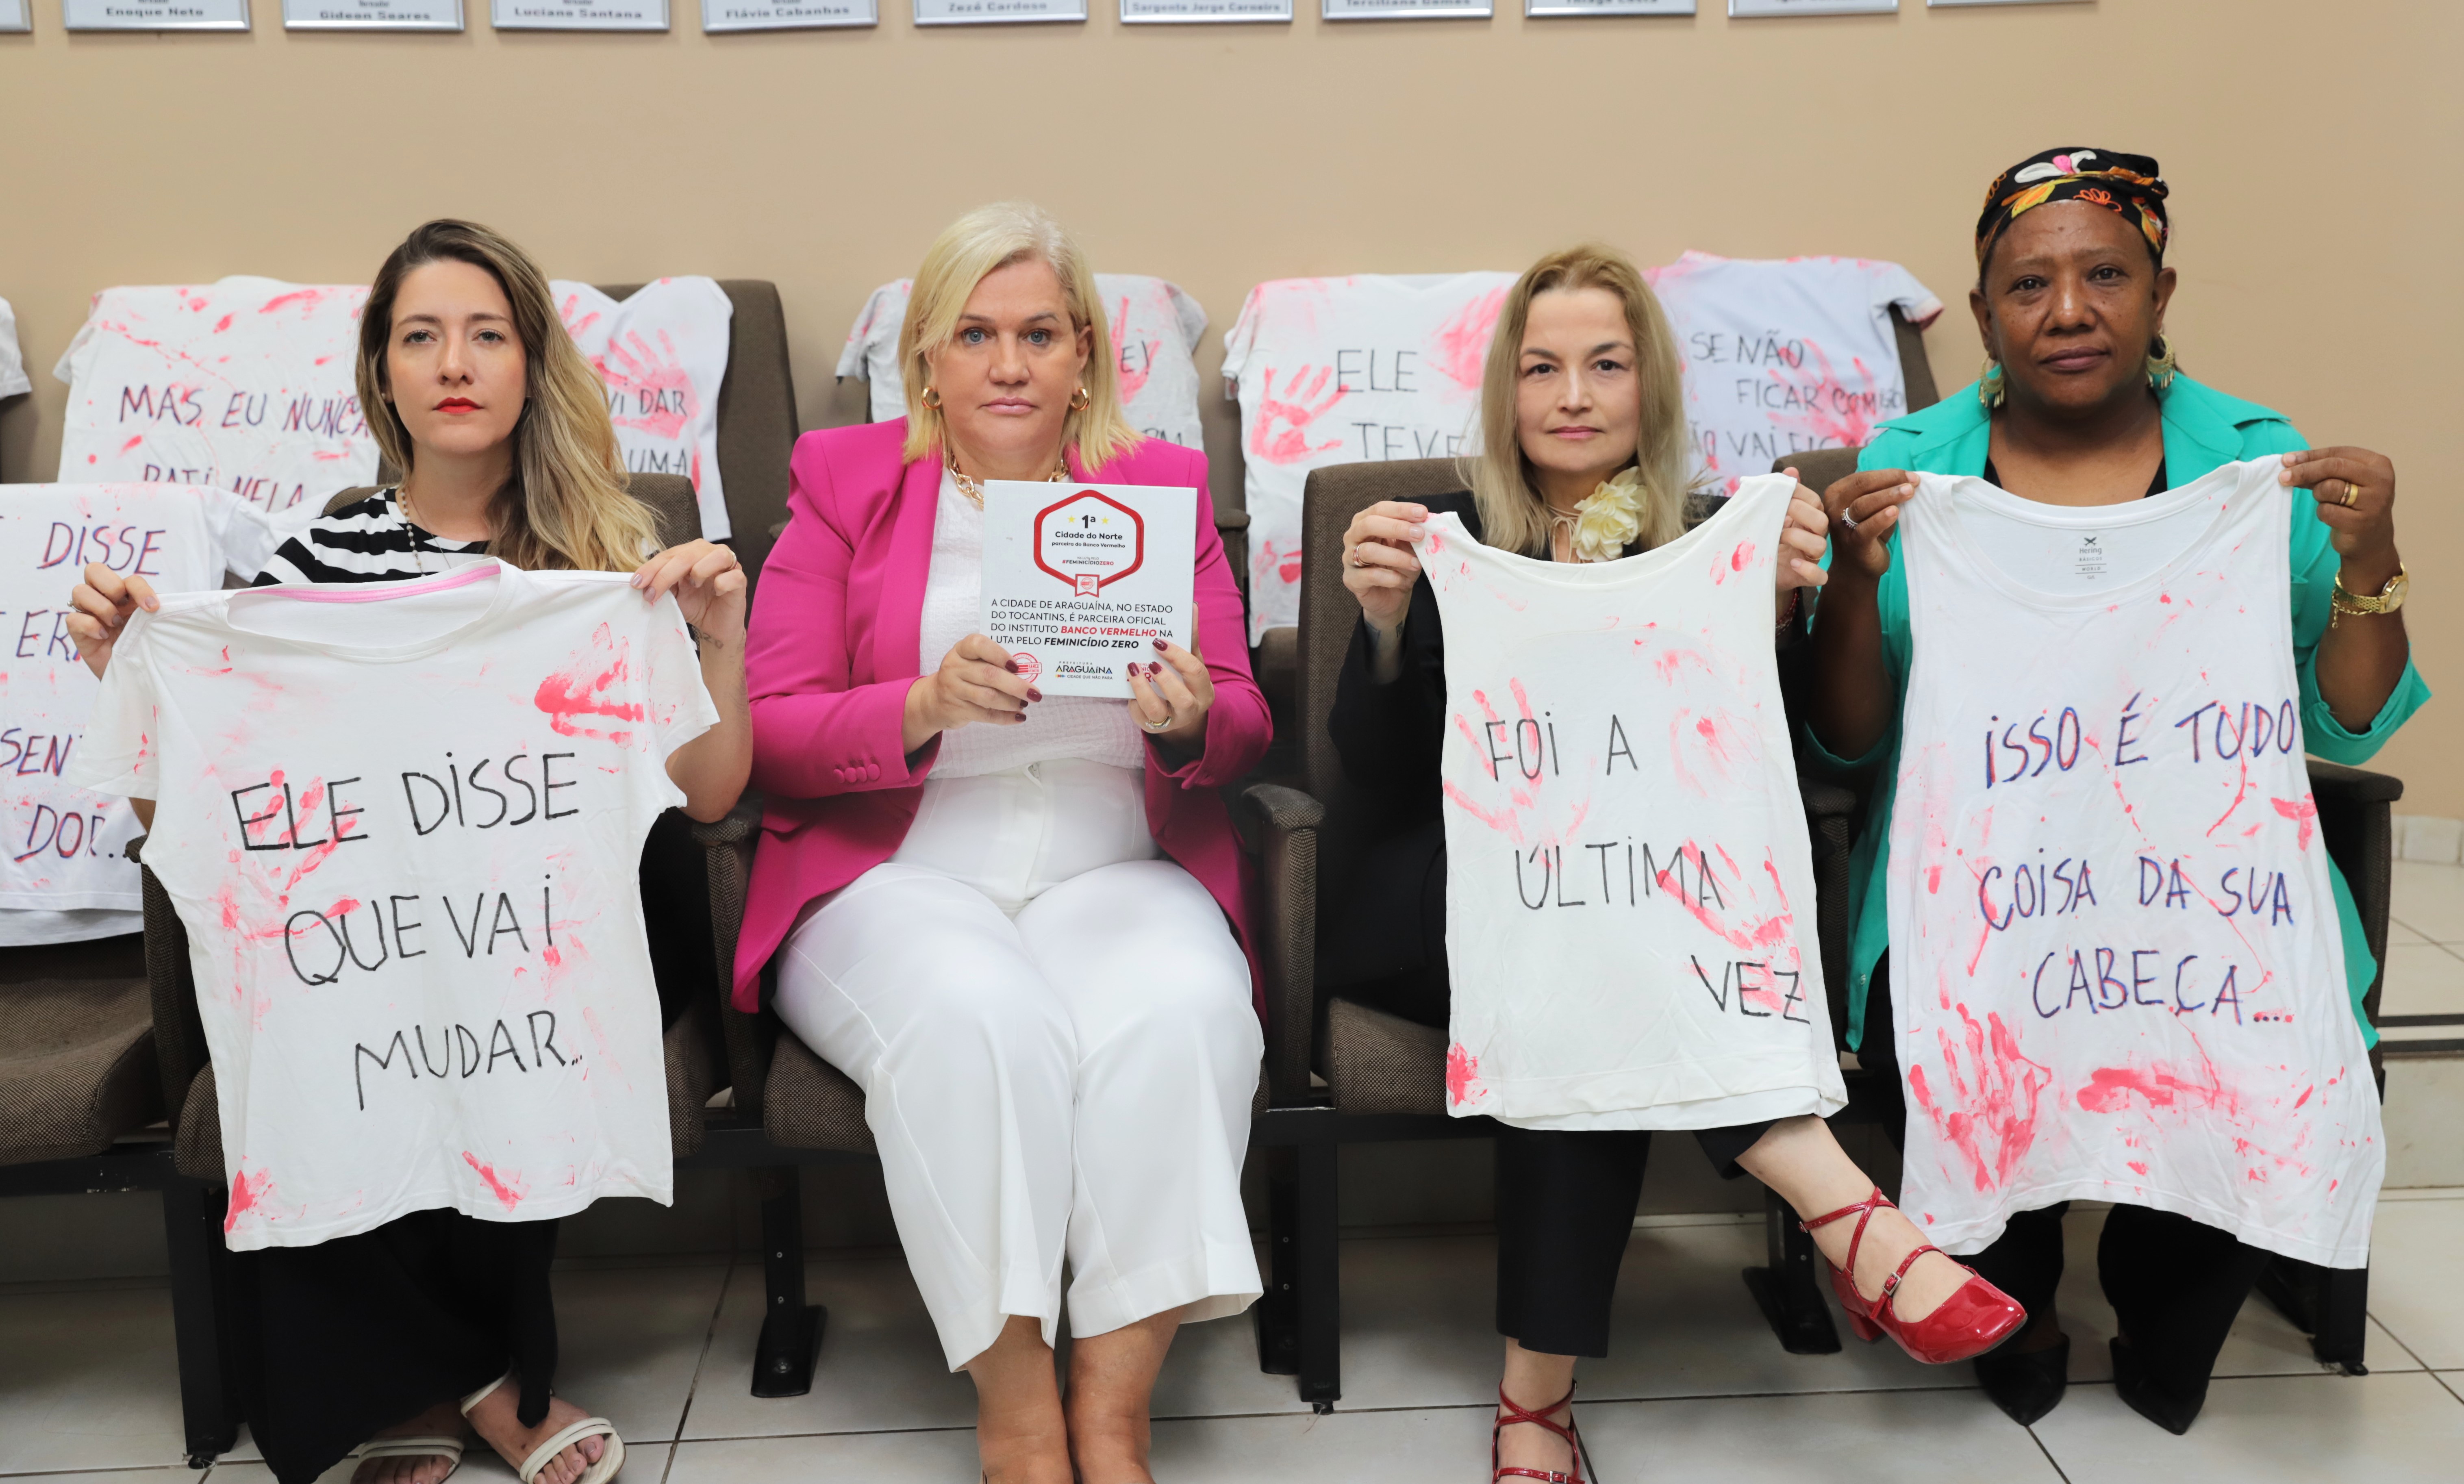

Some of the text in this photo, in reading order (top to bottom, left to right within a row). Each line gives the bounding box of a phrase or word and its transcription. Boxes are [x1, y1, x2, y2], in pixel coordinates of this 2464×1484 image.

[106, 8, 204, 18] Enoque Neto
[319, 11, 430, 20] Gideon Soares
[579, 8, 642, 18] Santana
[726, 8, 770, 18] Flávio
[988, 2, 1047, 10] Cardoso
[1690, 329, 1804, 369] SE NÃO
[1336, 349, 1419, 393] ELE
[119, 384, 204, 426] MAS
[221, 391, 267, 428] EU
[640, 388, 688, 417] DAR
[1736, 379, 1824, 413] FICAR
[628, 448, 687, 474] UMA
[1000, 599, 1036, 608] CIDADE
[1055, 600, 1114, 612] ARAGUAÍNA,
[1117, 603, 1132, 611] NO
[1135, 604, 1173, 613] ESTADO
[1008, 611, 1067, 622] TOCANTINS,
[1070, 612, 1075, 621] É
[1078, 614, 1124, 623] PARCEIRA
[1127, 616, 1166, 625] OFICIAL
[1009, 624, 1058, 633] INSTITUTO
[1061, 626, 1097, 634] BANCO
[1100, 627, 1157, 637] VERMELHO
[1160, 630, 1173, 638] NA
[1017, 637, 1041, 645] PELO
[1044, 637, 1109, 647] FEMINICÍDIO
[1111, 640, 1139, 648] ZERO
[2115, 692, 2148, 766] É
[2174, 699, 2295, 764] TUDO
[1607, 714, 1639, 776] A
[230, 776, 370, 850] ELE
[2138, 856, 2191, 910] DA
[2217, 866, 2294, 926] SUA
[285, 894, 426, 986] QUE
[1690, 954, 1811, 1025] VEZ
